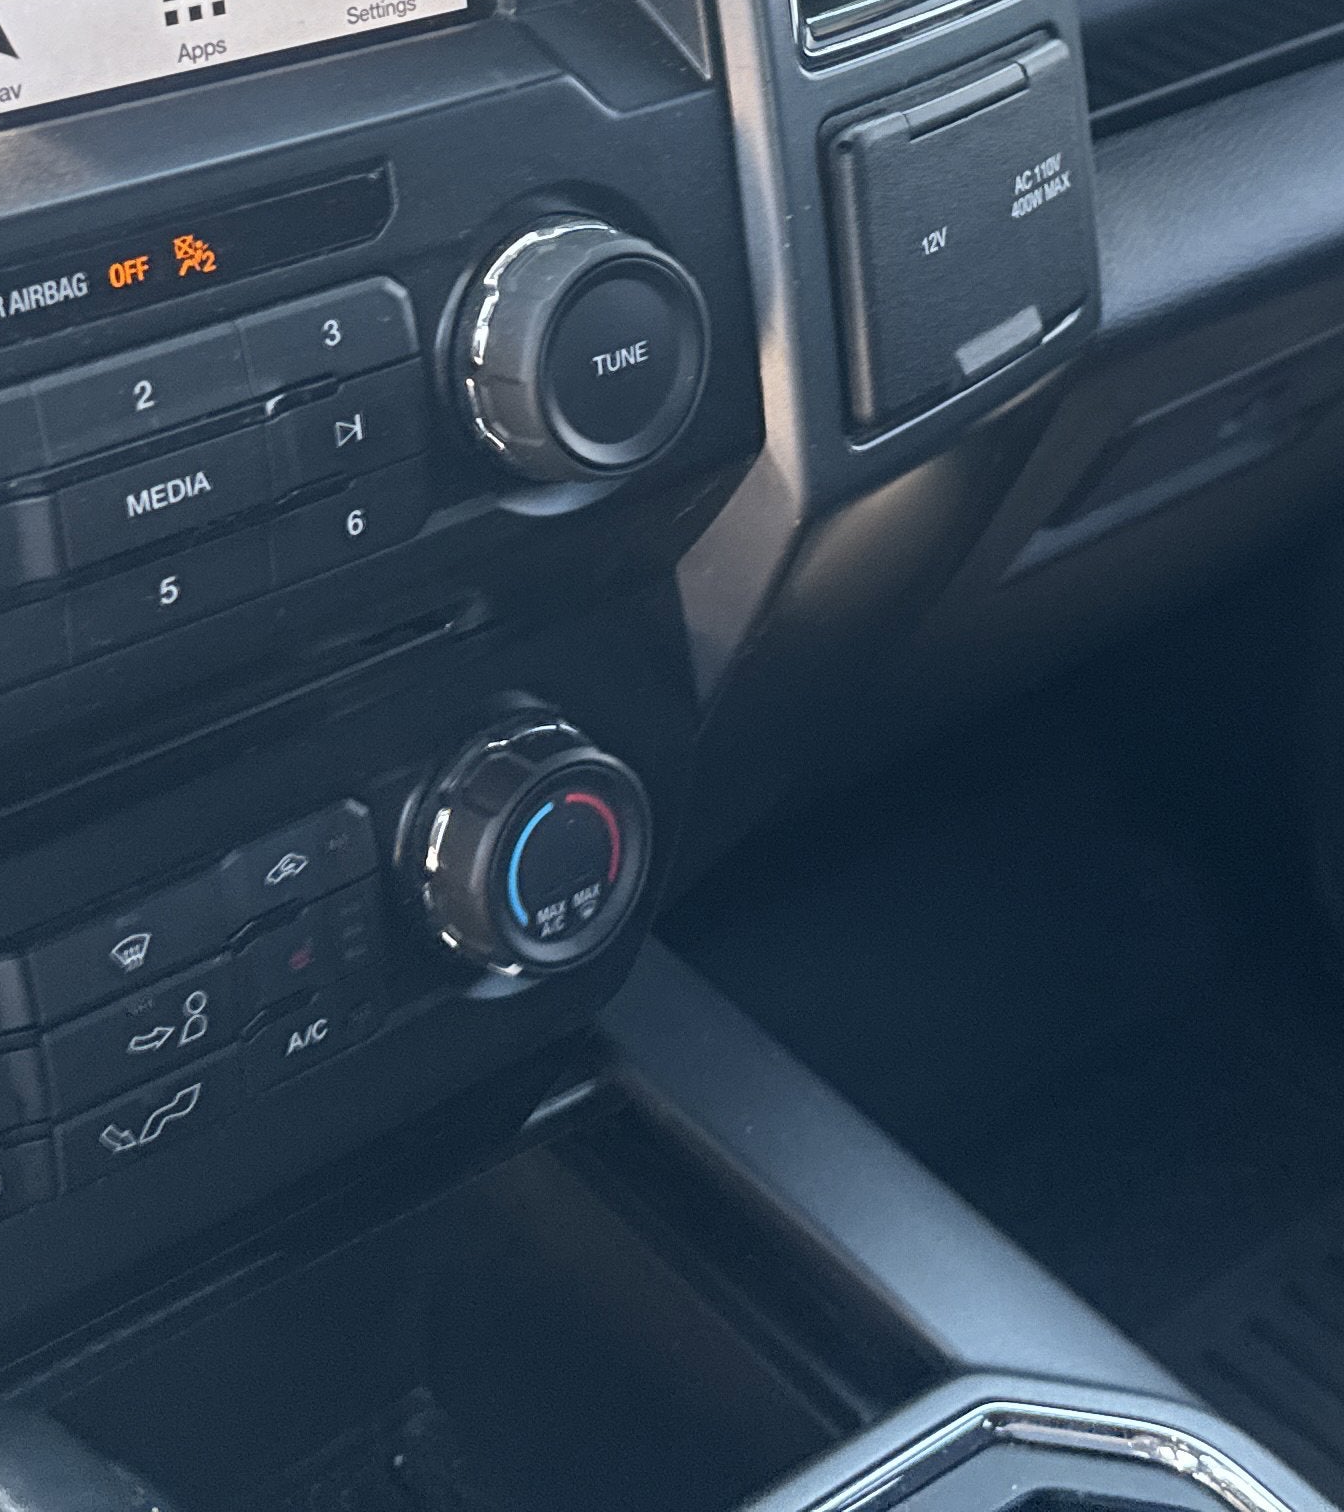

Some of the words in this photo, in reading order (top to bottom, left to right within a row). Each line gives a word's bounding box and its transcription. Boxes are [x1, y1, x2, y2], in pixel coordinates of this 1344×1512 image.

[178, 38, 228, 66] Apps
[1014, 170, 1033, 196] AC
[1033, 152, 1062, 183] 110V
[1043, 169, 1071, 201] MAX
[921, 226, 947, 255] 12V
[8, 272, 89, 316] AIRBAG
[108, 255, 149, 288] OFF
[323, 319, 342, 347] 3
[592, 340, 648, 376] TUNE
[133, 380, 155, 411] 2
[126, 471, 212, 517] MEDIA
[346, 509, 364, 536] 6
[160, 576, 179, 605] 5
[573, 883, 600, 907] MAX
[536, 900, 566, 925] MAX
[286, 1018, 328, 1056] A/C
